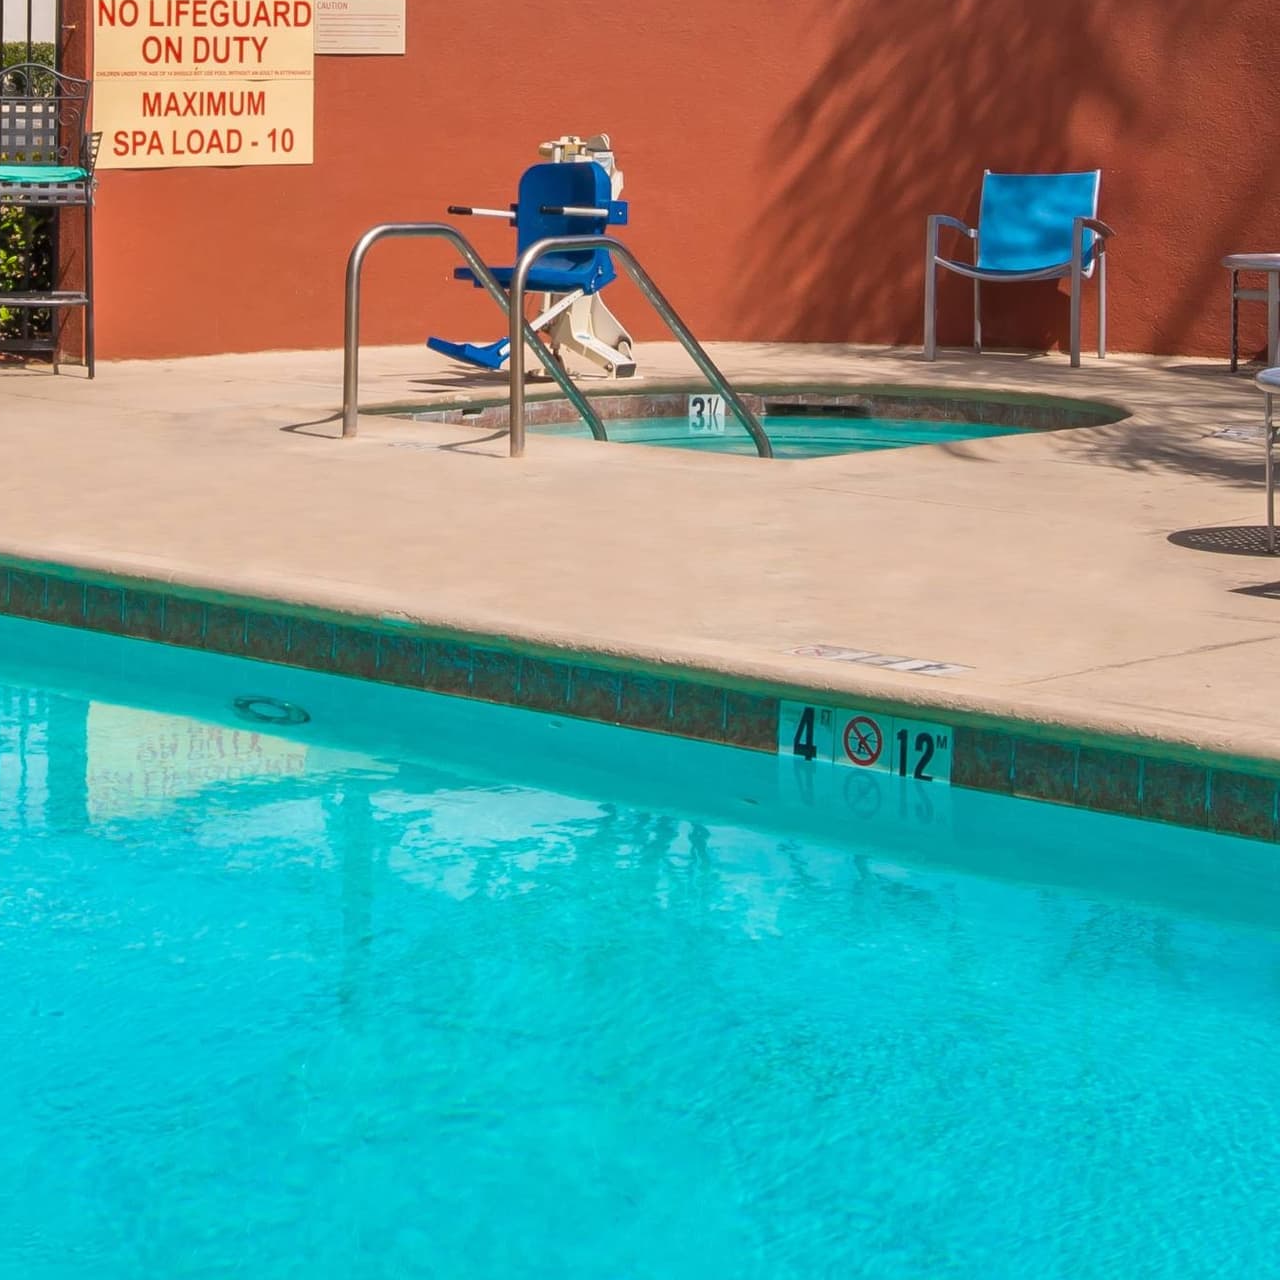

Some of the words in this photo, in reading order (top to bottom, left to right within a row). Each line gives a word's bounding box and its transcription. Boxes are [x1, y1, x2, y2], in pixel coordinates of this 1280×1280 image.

[98, 0, 139, 27] NO
[149, 0, 311, 28] LIFEGUARD
[317, 1, 348, 10] CAUTION
[142, 36, 183, 64] ON
[193, 36, 268, 63] DUTY
[142, 91, 266, 118] MAXIMUM
[113, 131, 164, 156] SPA
[172, 129, 241, 154] LOAD
[267, 128, 294, 153] 10
[794, 707, 816, 761] 4
[821, 710, 832, 724] FT
[897, 729, 934, 781] 12
[937, 736, 947, 749] M
